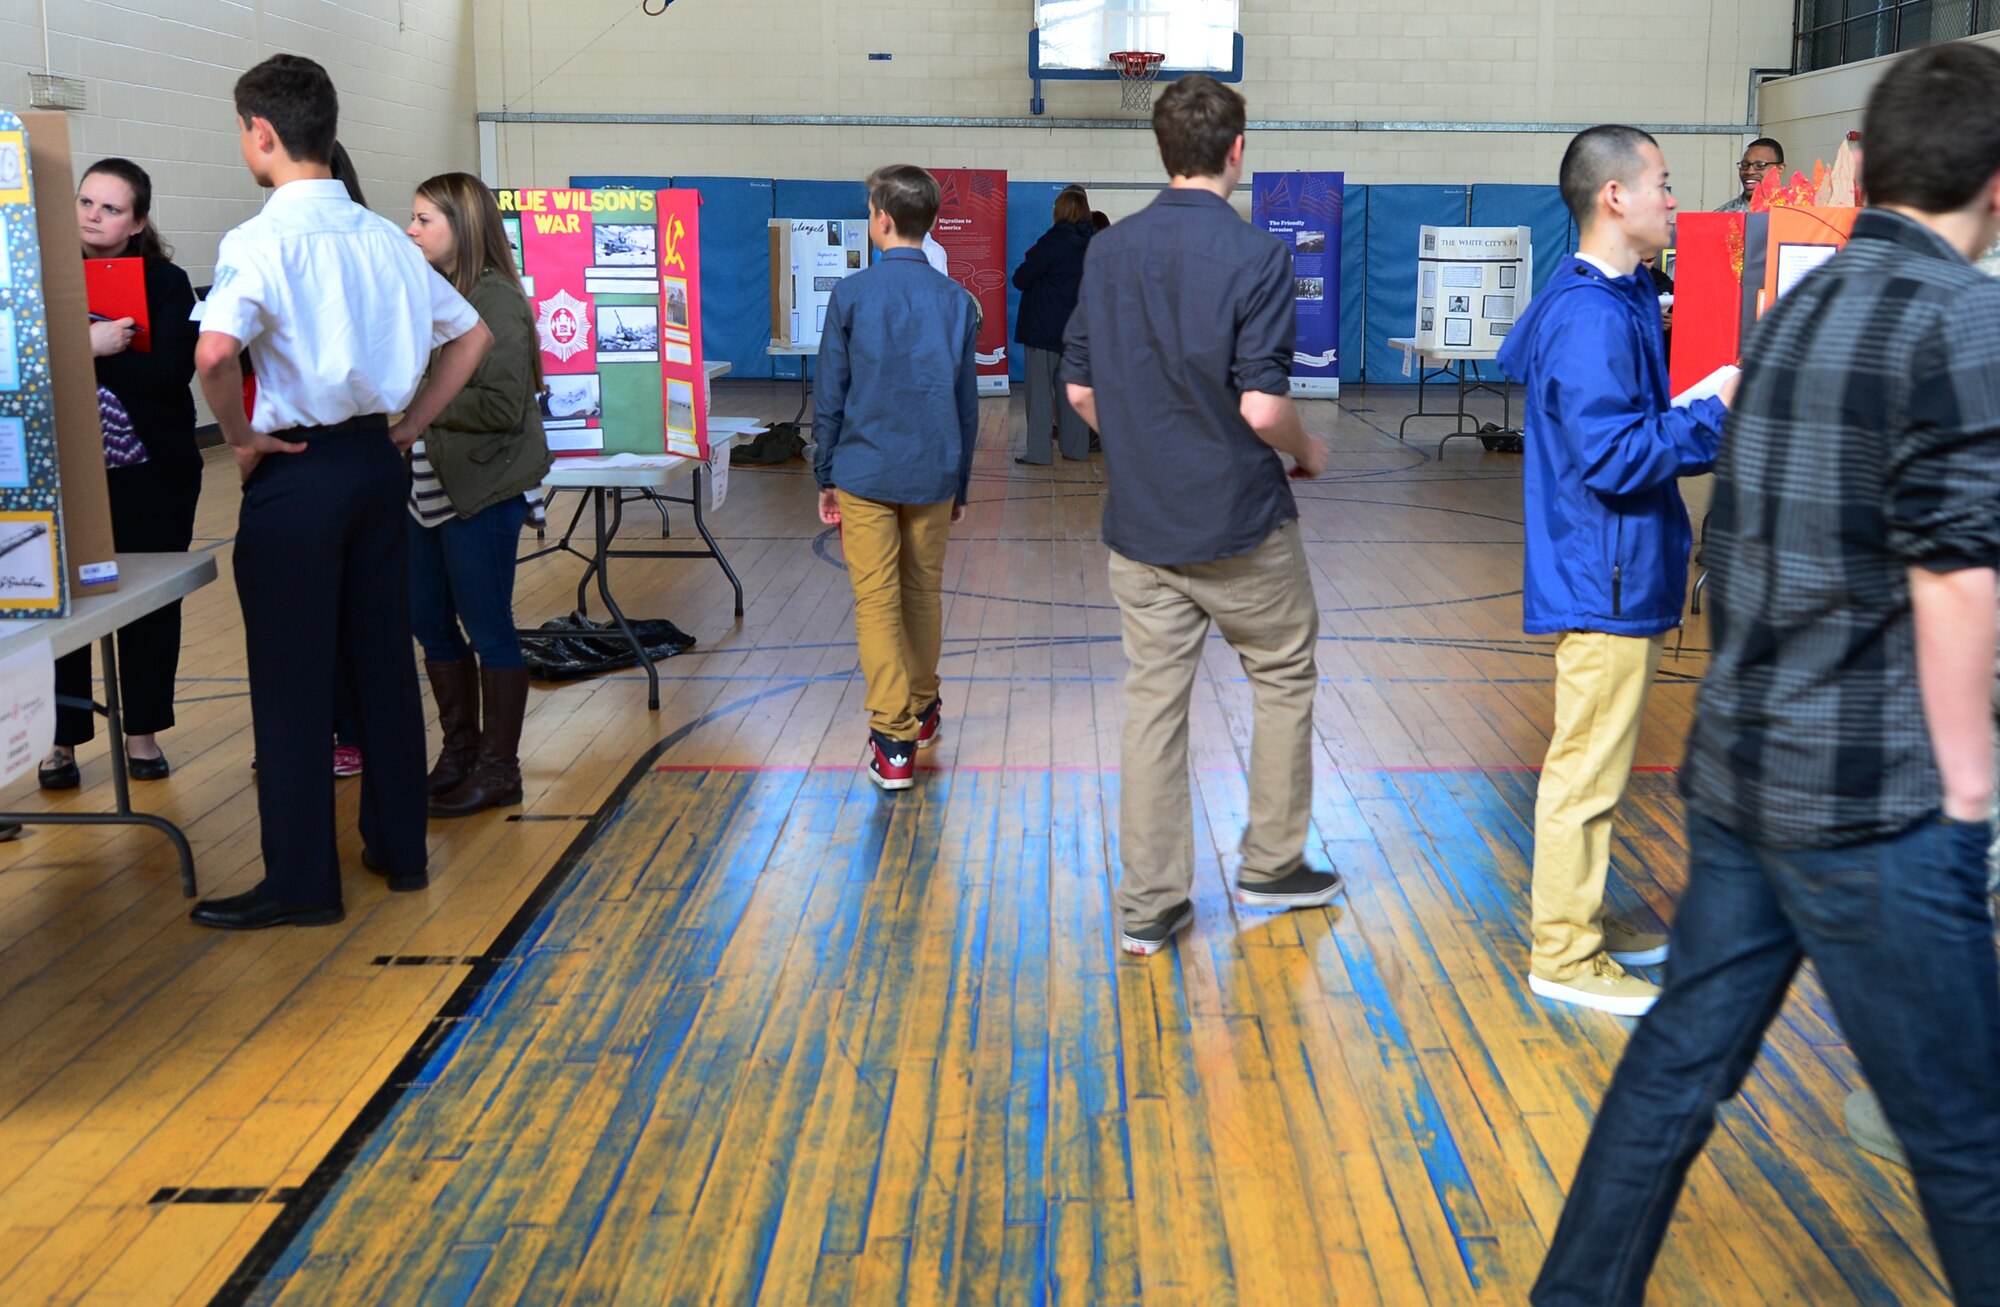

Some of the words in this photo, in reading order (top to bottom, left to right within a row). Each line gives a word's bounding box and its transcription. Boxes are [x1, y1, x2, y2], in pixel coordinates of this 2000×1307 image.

[497, 190, 547, 212] RLIE
[552, 190, 654, 212] WILSON'S
[533, 213, 581, 234] WAR
[1441, 239, 1455, 247] THE
[1459, 239, 1482, 247] WHITE
